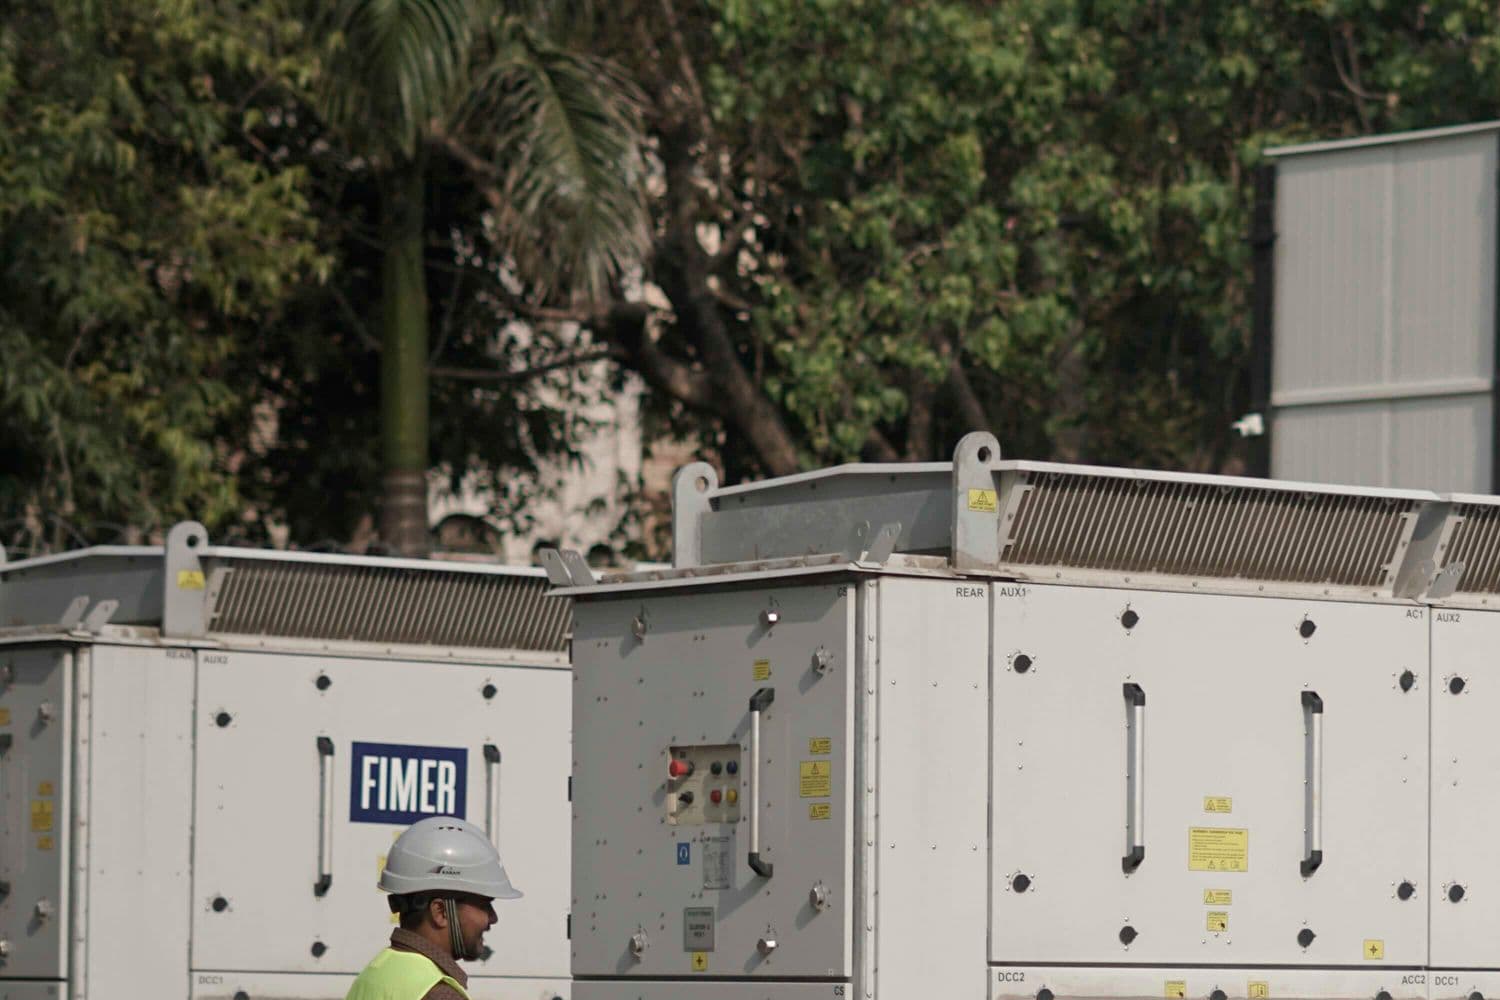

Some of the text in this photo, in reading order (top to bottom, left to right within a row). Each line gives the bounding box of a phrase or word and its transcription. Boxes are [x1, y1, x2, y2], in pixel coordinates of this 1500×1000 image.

[956, 587, 984, 597] REAR
[1000, 587, 1027, 597] AUX1
[1406, 609, 1424, 619] AC1
[1437, 613, 1461, 623] AUX2
[361, 755, 456, 815] FIMER
[998, 972, 1025, 982] DCC2
[1401, 975, 1426, 985] ACC2
[1434, 976, 1459, 986] DCC1
